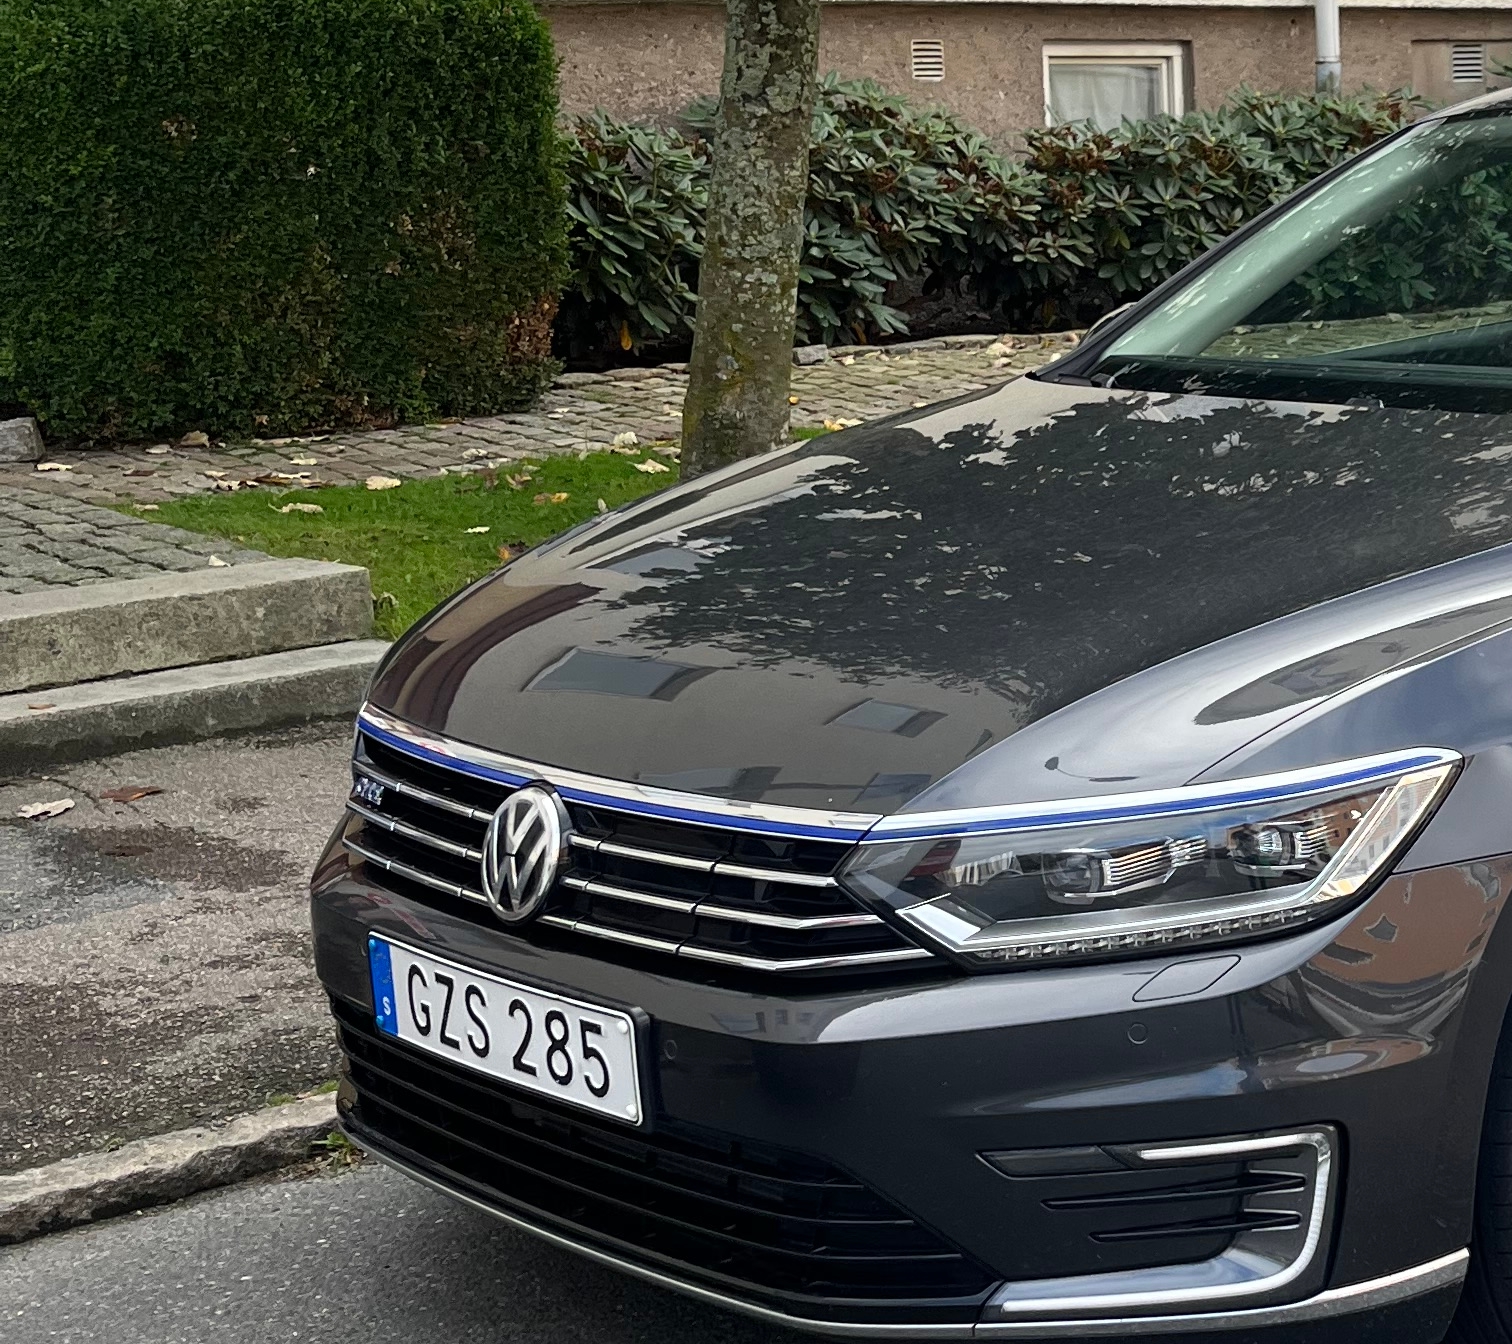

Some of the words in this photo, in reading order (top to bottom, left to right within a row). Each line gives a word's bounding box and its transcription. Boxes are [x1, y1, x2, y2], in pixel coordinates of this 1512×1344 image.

[382, 996, 391, 1016] S
[407, 963, 490, 1058] GZS
[508, 998, 610, 1098] 285
